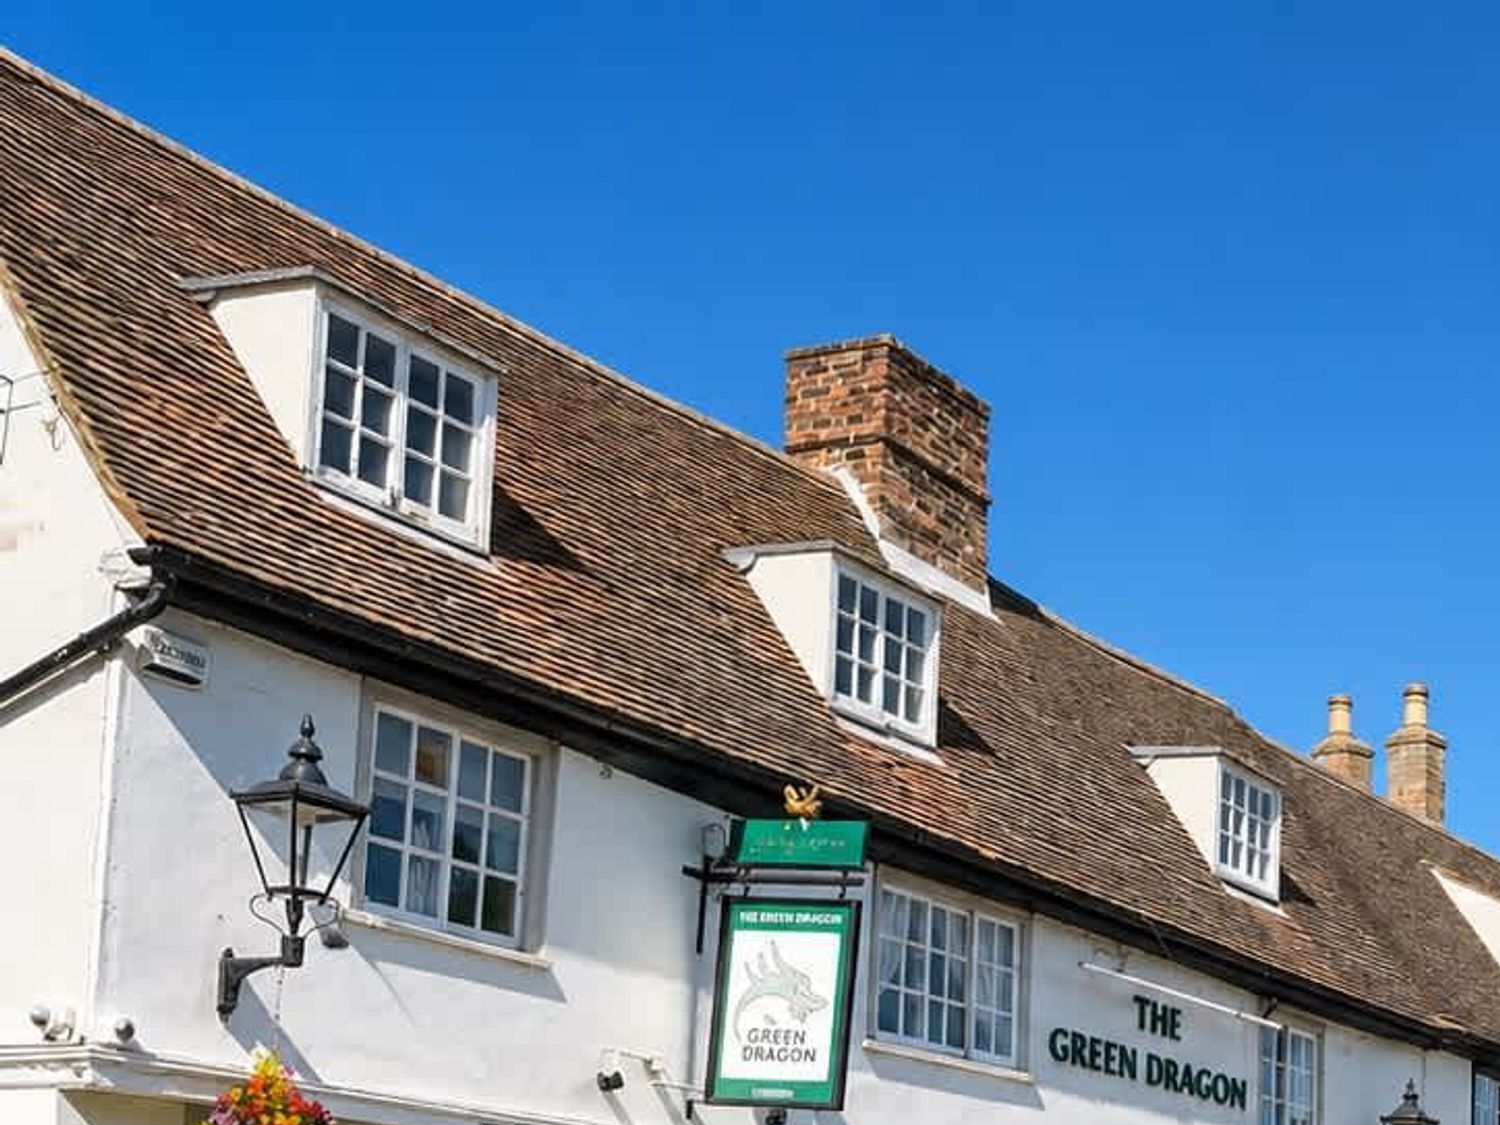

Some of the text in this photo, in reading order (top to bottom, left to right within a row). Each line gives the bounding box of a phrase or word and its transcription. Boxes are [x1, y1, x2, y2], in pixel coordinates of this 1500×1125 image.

[1133, 994, 1182, 1042] THE
[747, 1027, 806, 1046] GREEN
[742, 1045, 817, 1063] DRAGON
[1048, 1027, 1248, 1112] GREEN DRAGON
